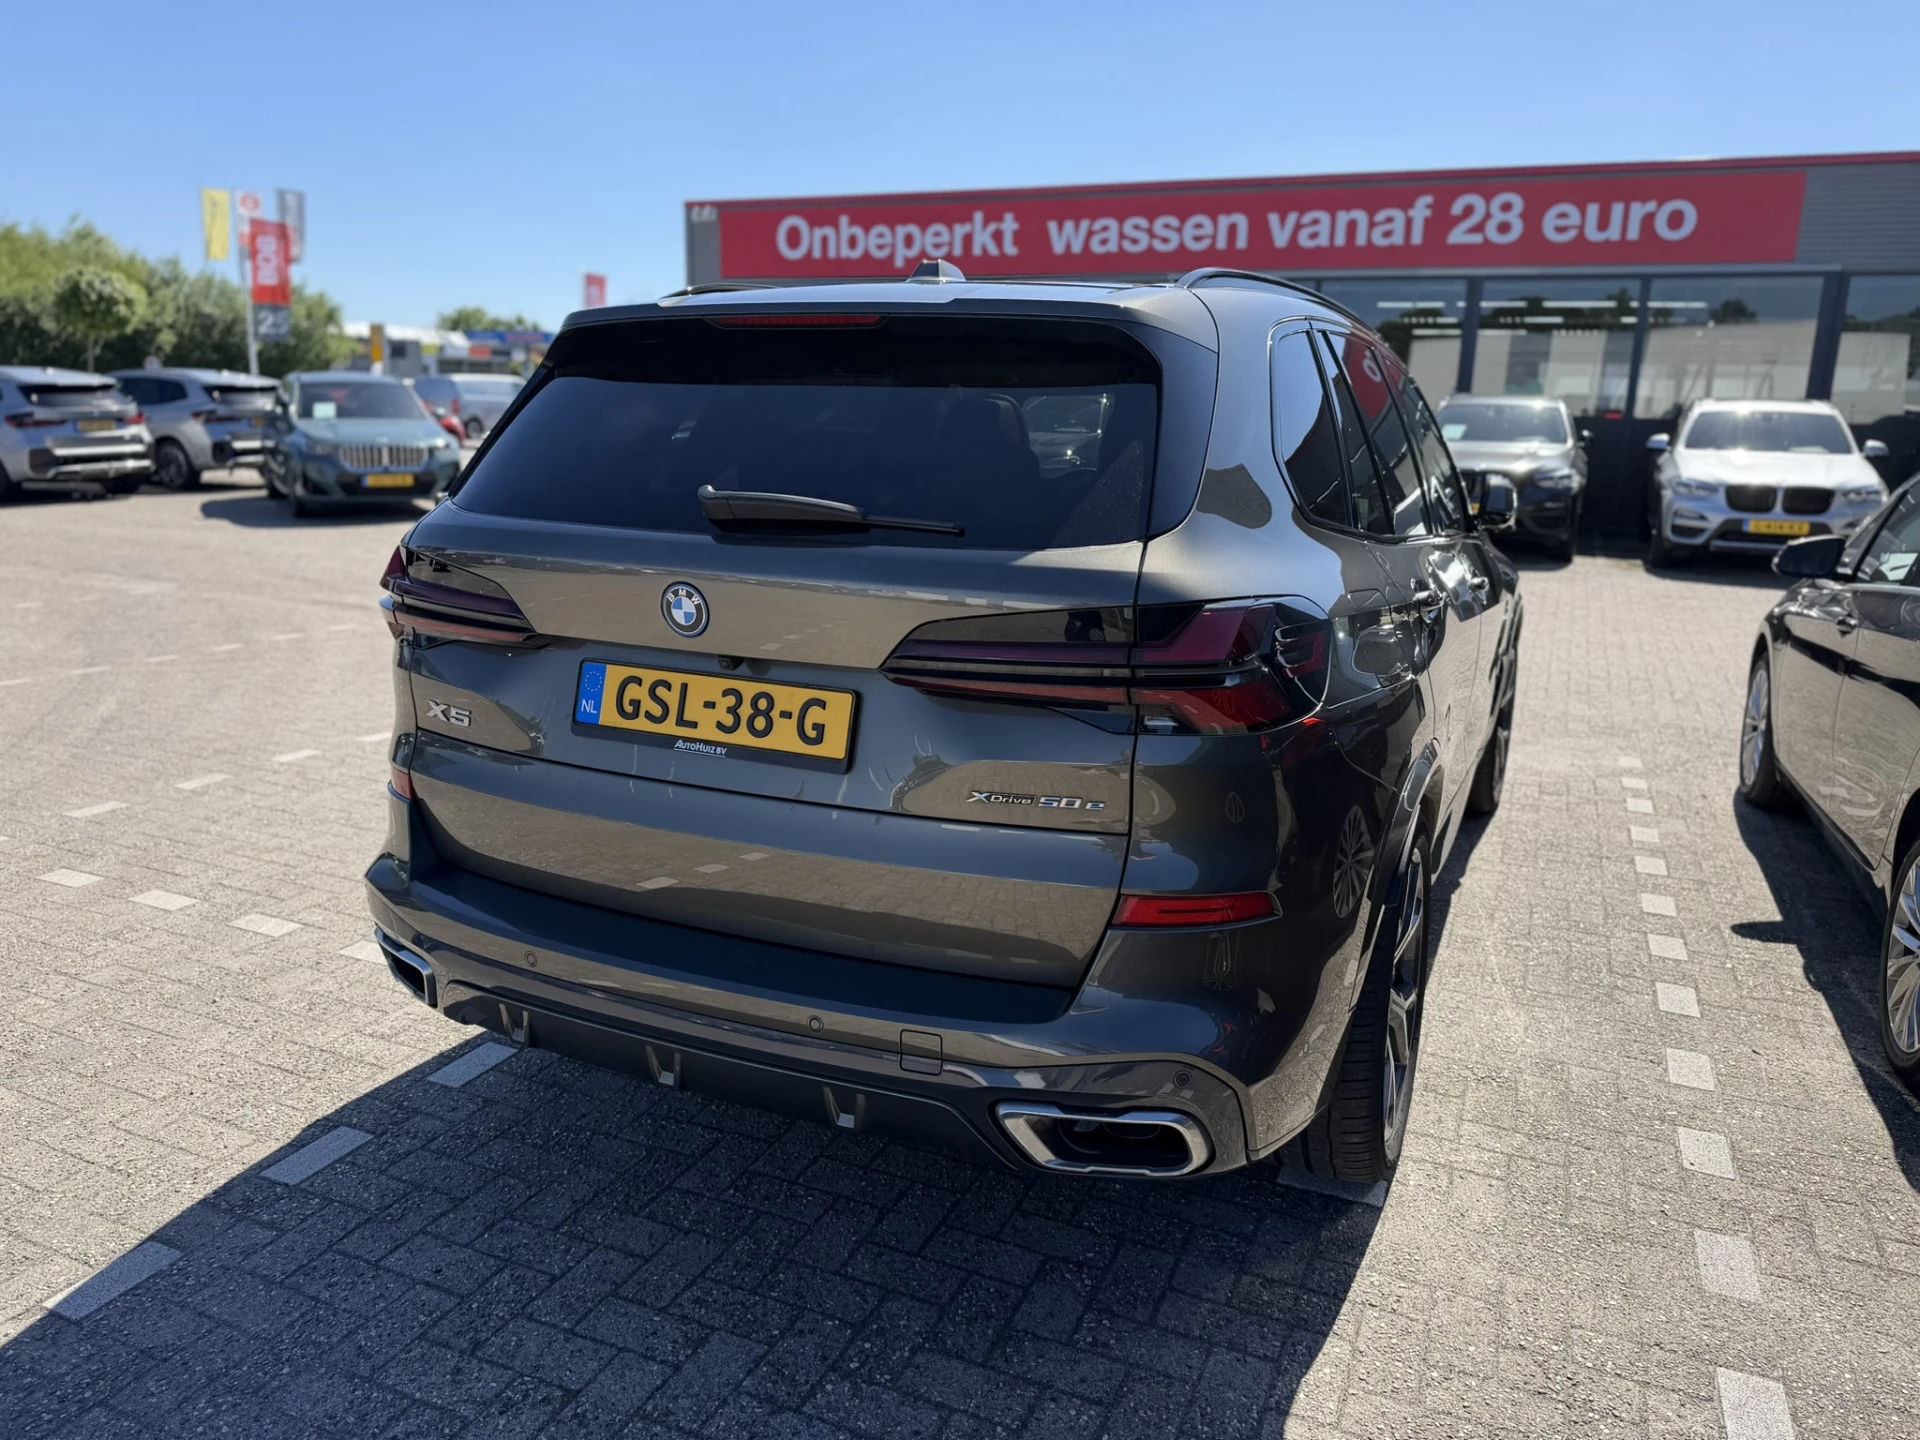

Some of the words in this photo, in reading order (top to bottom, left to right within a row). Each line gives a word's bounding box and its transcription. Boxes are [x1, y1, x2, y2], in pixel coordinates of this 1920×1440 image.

[775, 211, 1020, 268] Onbeperkt
[1046, 211, 1250, 256] wassen
[1268, 195, 1434, 249] vanaf
[1446, 191, 1525, 246] 28
[1541, 197, 1699, 244] euro
[666, 588, 702, 606] BMW
[424, 698, 472, 727] X5
[580, 698, 599, 714] NL
[614, 674, 828, 746] GSL-38-G
